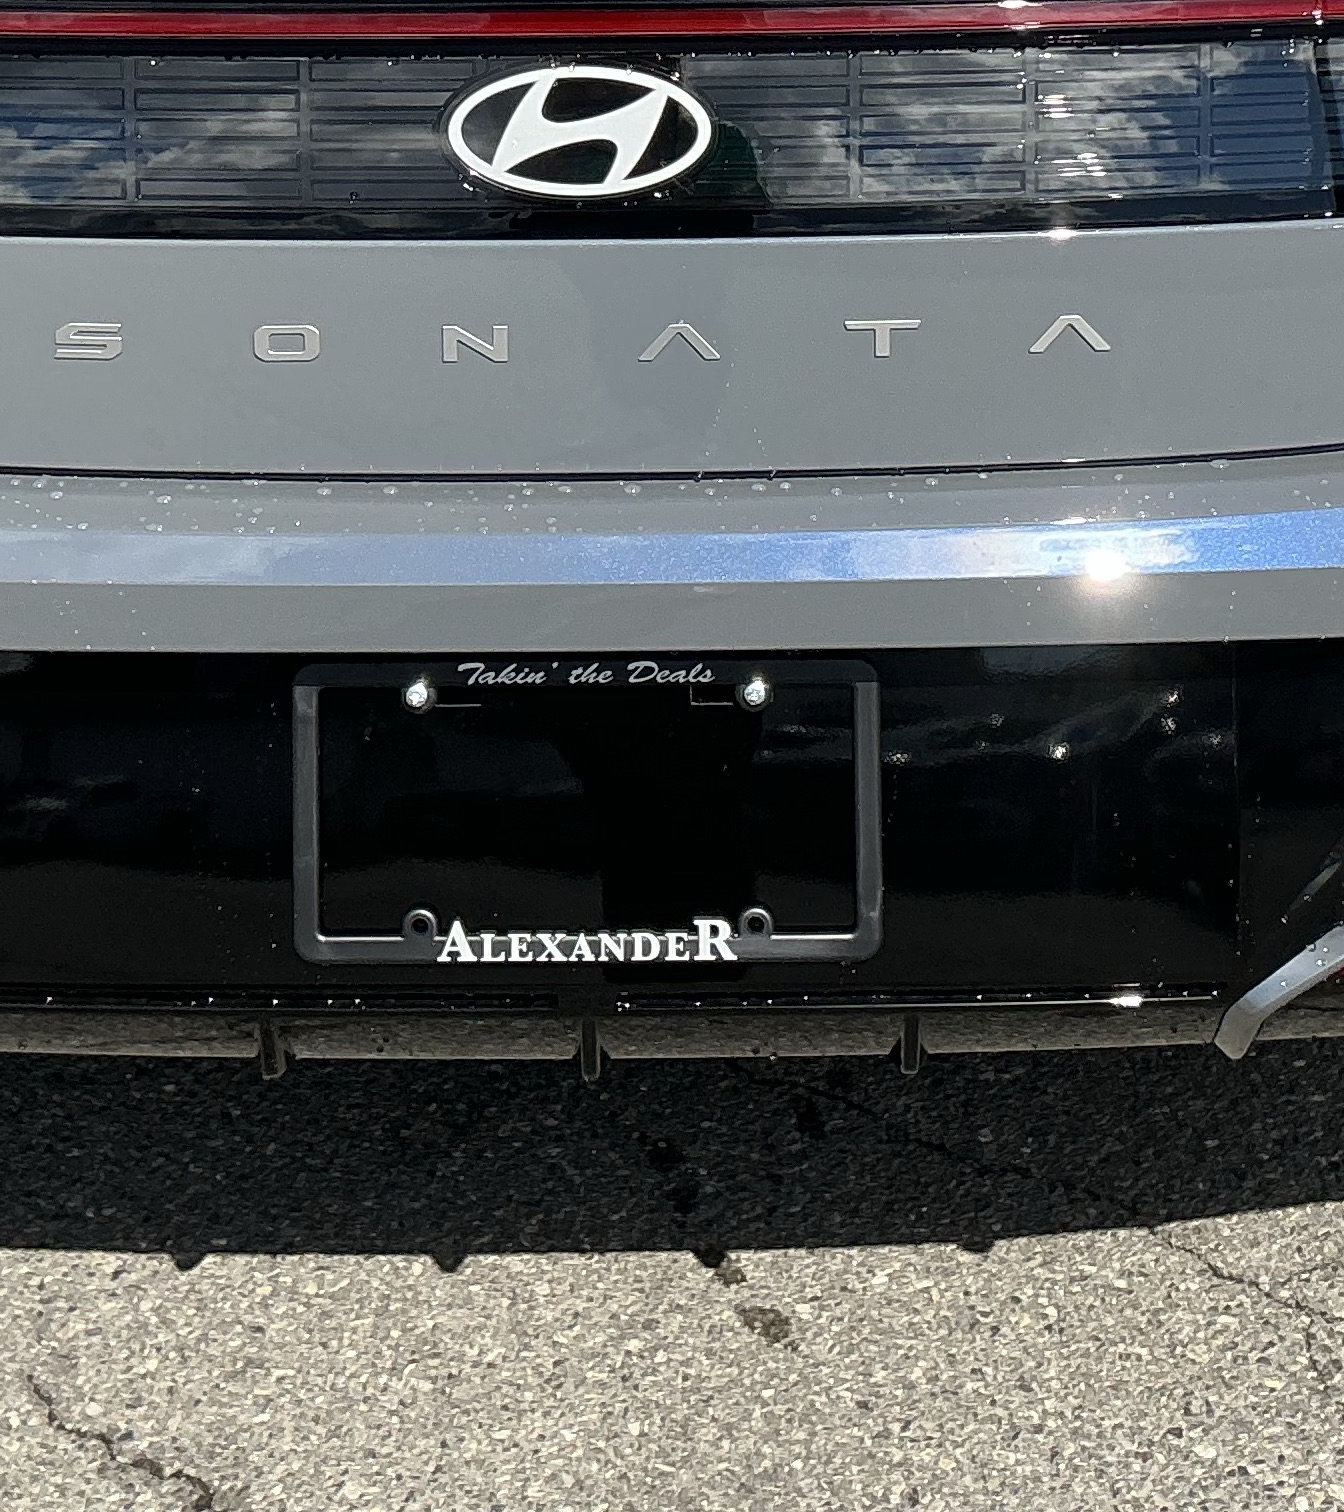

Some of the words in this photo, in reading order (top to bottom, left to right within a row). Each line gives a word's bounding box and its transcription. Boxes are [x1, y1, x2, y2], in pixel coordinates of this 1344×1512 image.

[53, 314, 1112, 363] SONATA
[457, 661, 559, 686] Takin'
[568, 662, 614, 685] the
[627, 660, 716, 684] Deals
[436, 918, 739, 963] ALEXANDER
